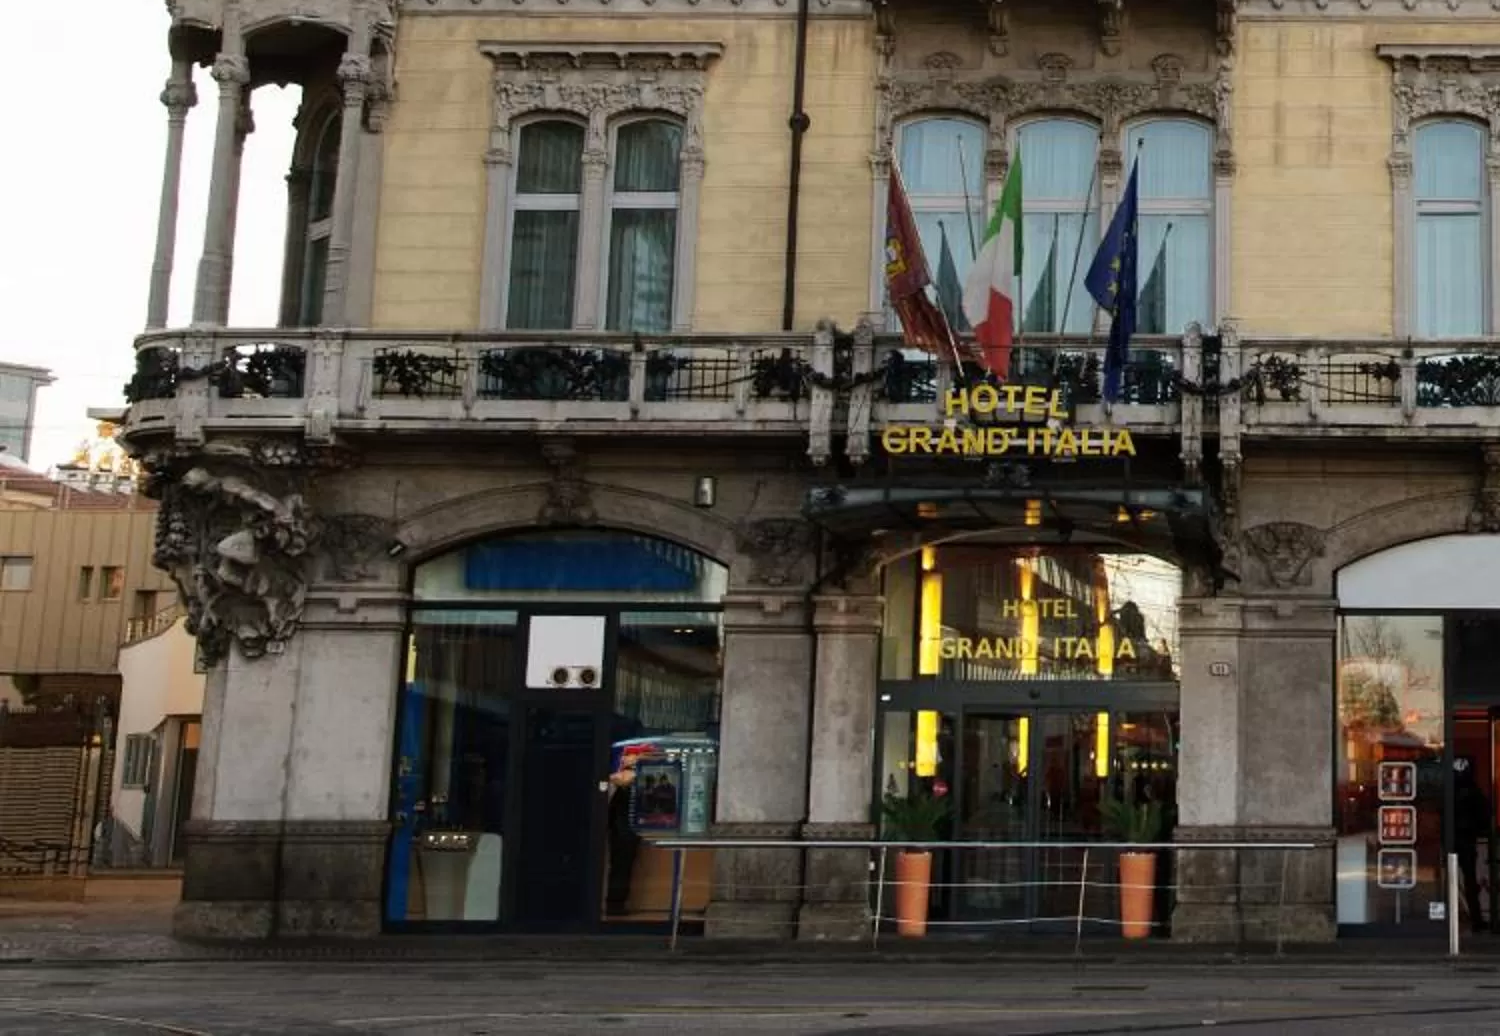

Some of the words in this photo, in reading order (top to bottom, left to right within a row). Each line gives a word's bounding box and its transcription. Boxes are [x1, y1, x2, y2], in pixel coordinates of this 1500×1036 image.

[944, 383, 1069, 419] HOTEL
[882, 426, 1018, 454] GRAND'
[1027, 427, 1137, 456] ITALIA
[1002, 598, 1078, 618] HOTEL
